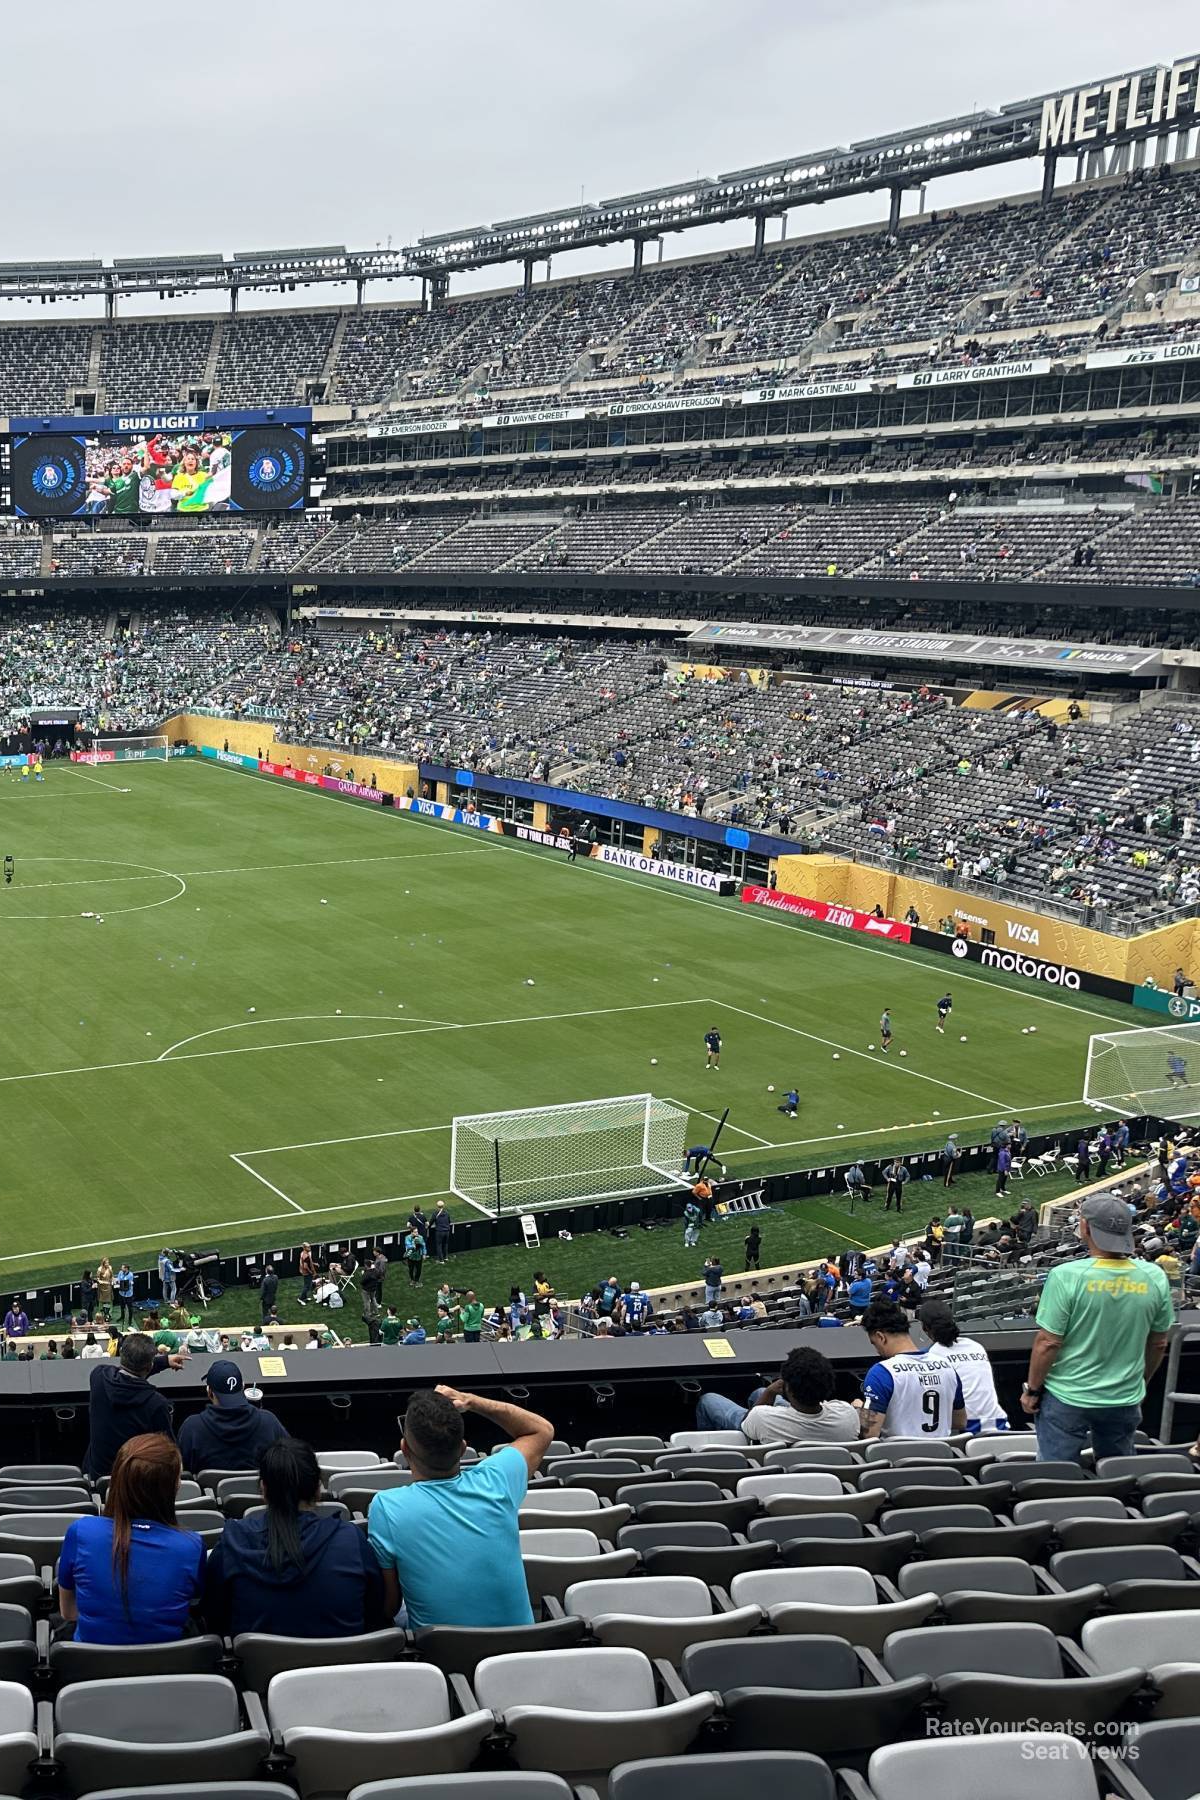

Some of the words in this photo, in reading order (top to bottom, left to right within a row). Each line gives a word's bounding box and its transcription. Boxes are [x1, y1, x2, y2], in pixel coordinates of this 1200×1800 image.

[1039, 60, 1200, 151] METLIF
[1164, 344, 1195, 358] LEON
[913, 373, 932, 386] 60
[936, 369, 970, 383] LARRY
[972, 362, 1033, 380] GRANTHAM
[759, 389, 776, 401] 99
[778, 385, 806, 398] MARK
[806, 382, 857, 396] GASTINEAU
[609, 404, 624, 415] 60
[625, 399, 681, 413] D'BRICKASHAW
[681, 396, 721, 408] FERGUSON
[118, 417, 151, 430] BUD
[153, 415, 199, 429] LIGHT
[496, 415, 510, 426] 80
[512, 413, 538, 424] WAYNE
[538, 410, 569, 422] CHREBET
[377, 427, 389, 436] 32
[391, 423, 421, 434] EMERSON
[421, 421, 448, 432] BOOZER
[846, 634, 897, 648] METLIFE
[896, 636, 954, 650] STADIUM
[1077, 652, 1128, 662] MetLife
[174, 747, 186, 756] PIF
[216, 750, 244, 766] Hisense
[338, 781, 358, 794] QATAR
[359, 786, 384, 801] AIRWAYS
[417, 799, 435, 816] VISA
[461, 812, 481, 828] VISA
[516, 827, 529, 840] NEW
[529, 829, 543, 843] YORK
[542, 833, 555, 846] NEW
[603, 849, 636, 868] BANK
[639, 858, 655, 872] OF
[657, 863, 718, 889] AMERICA
[752, 888, 817, 919] Budweiser
[824, 908, 855, 928] ZERO
[954, 908, 989, 926] Hisense
[1004, 919, 1040, 946] VISA
[981, 948, 1081, 990] motorola
[1087, 1276, 1148, 1297] crefisa
[633, 1302, 642, 1312] 13
[892, 1362, 926, 1373] SUPER
[918, 1375, 942, 1386] MEHDI
[921, 1390, 940, 1433] 9
